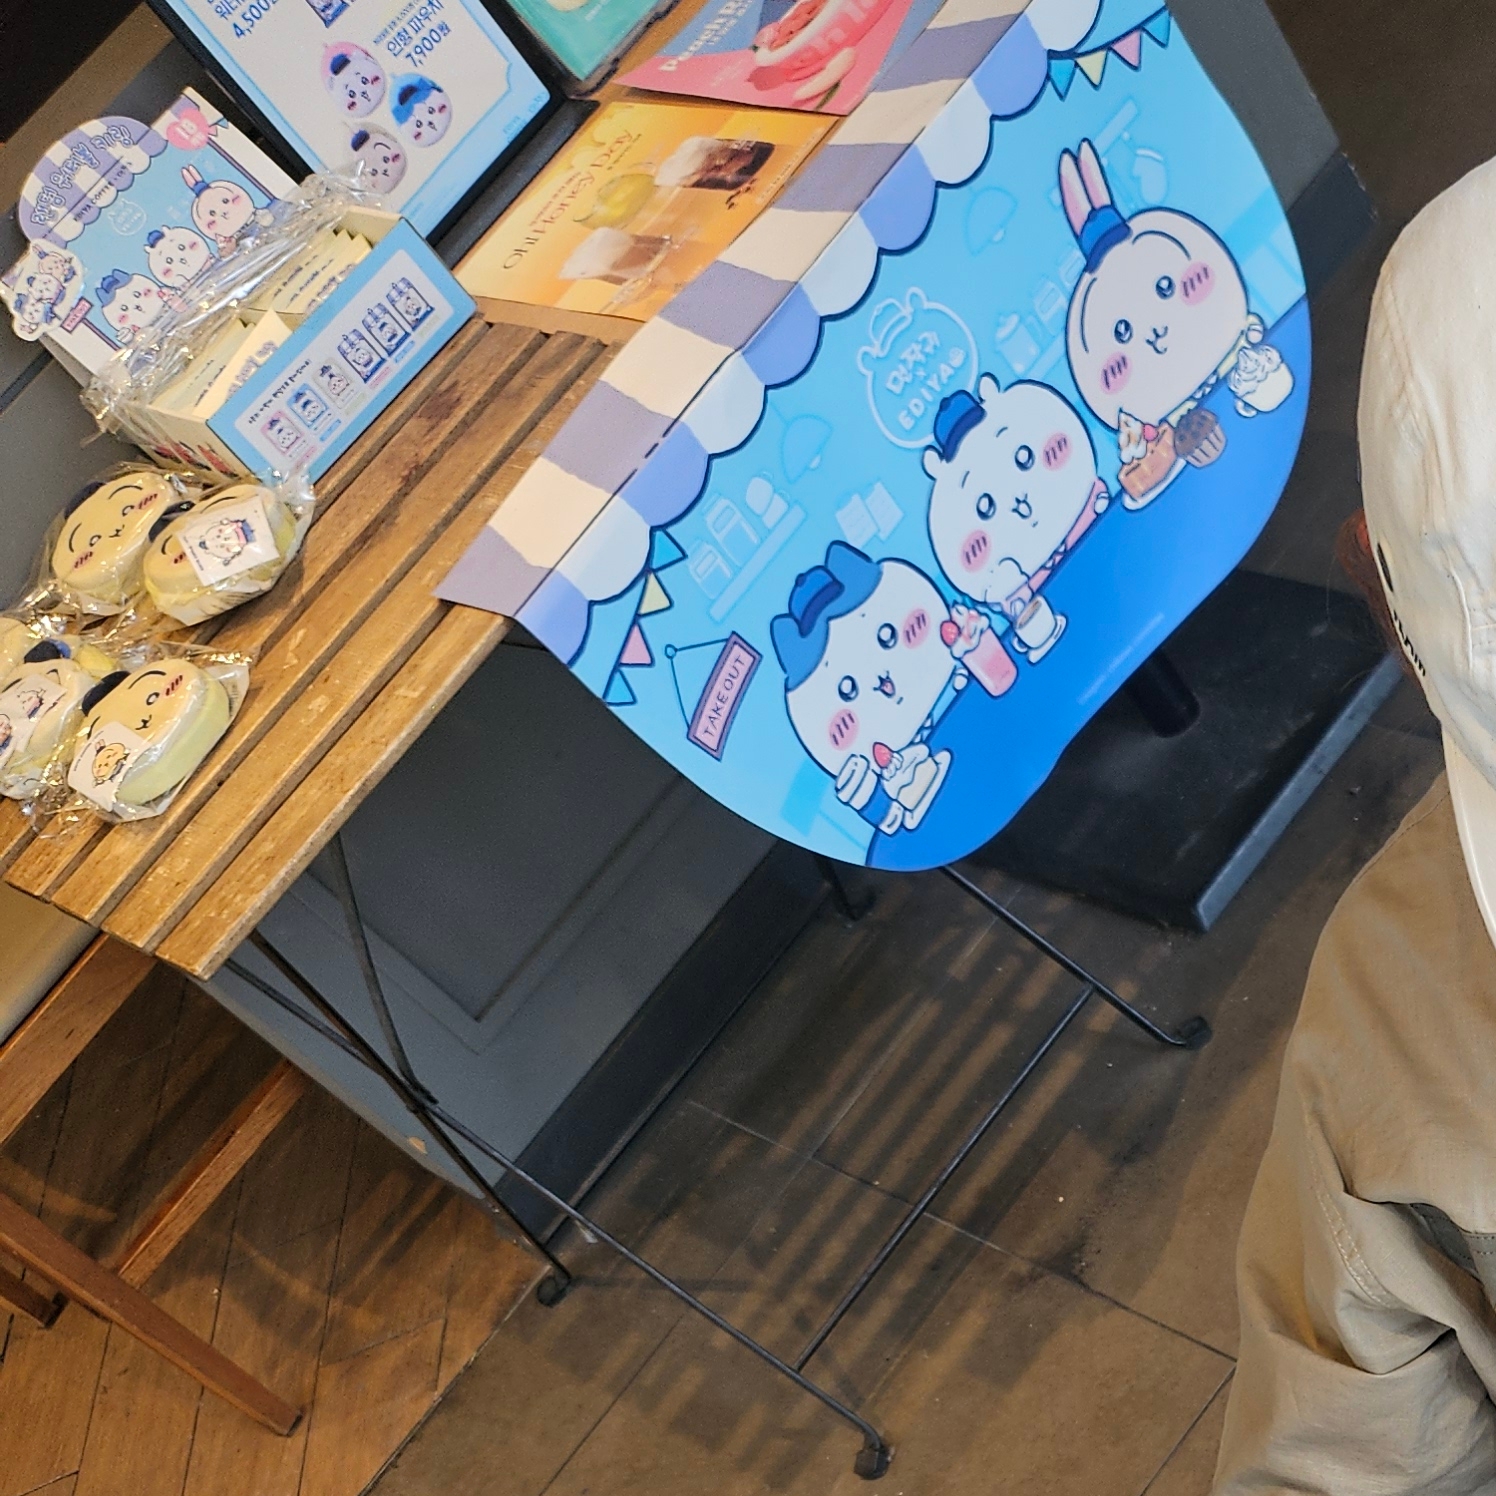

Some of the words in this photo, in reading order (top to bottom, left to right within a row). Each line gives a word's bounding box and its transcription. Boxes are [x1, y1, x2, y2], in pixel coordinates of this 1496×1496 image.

[233, 0, 277, 38] 4,500
[387, 28, 413, 57] 인형
[51, 142, 99, 189] 워터볼
[590, 129, 633, 168] Day
[898, 362, 954, 430] EDIYA
